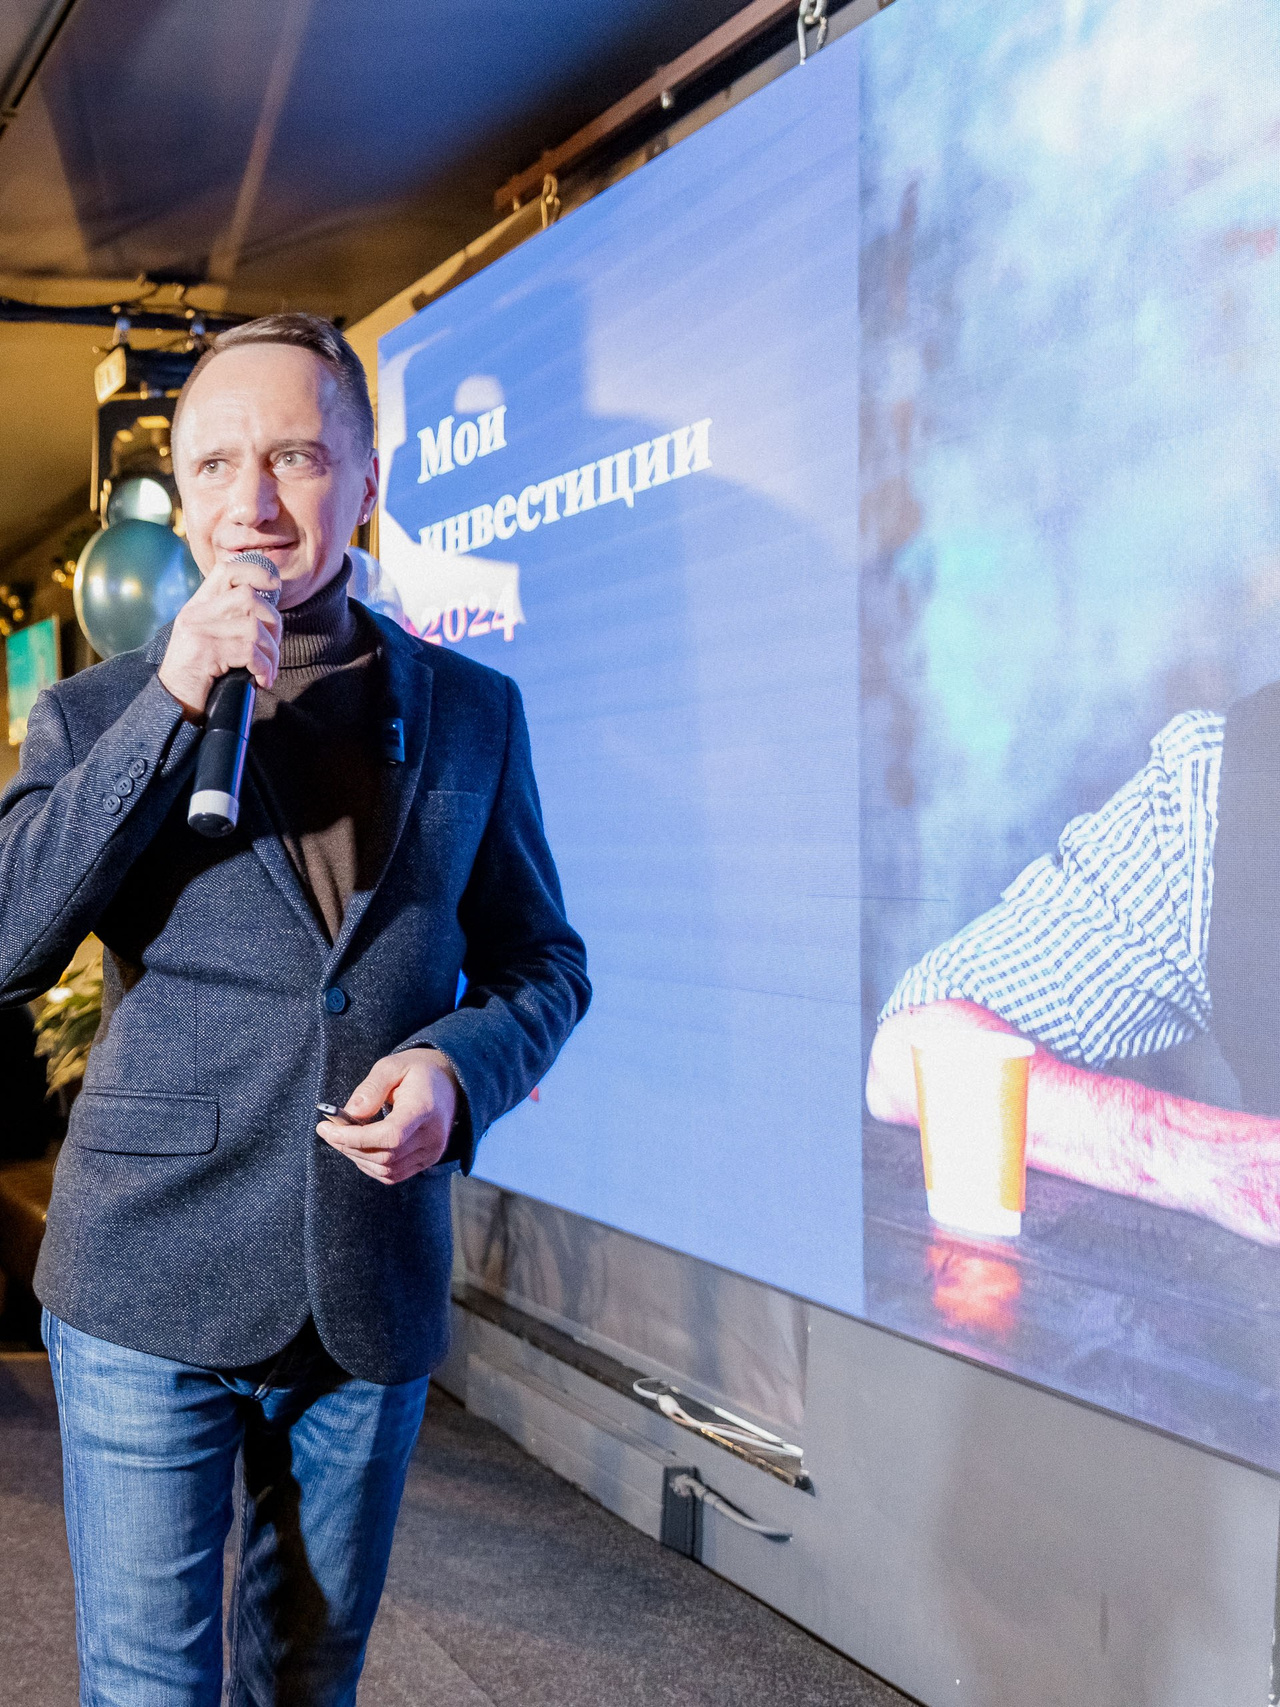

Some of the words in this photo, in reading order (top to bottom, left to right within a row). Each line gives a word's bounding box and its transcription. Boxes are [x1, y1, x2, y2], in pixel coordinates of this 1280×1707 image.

[417, 405, 507, 483] Мои
[418, 417, 713, 556] инвестиции
[420, 585, 517, 646] 2024
